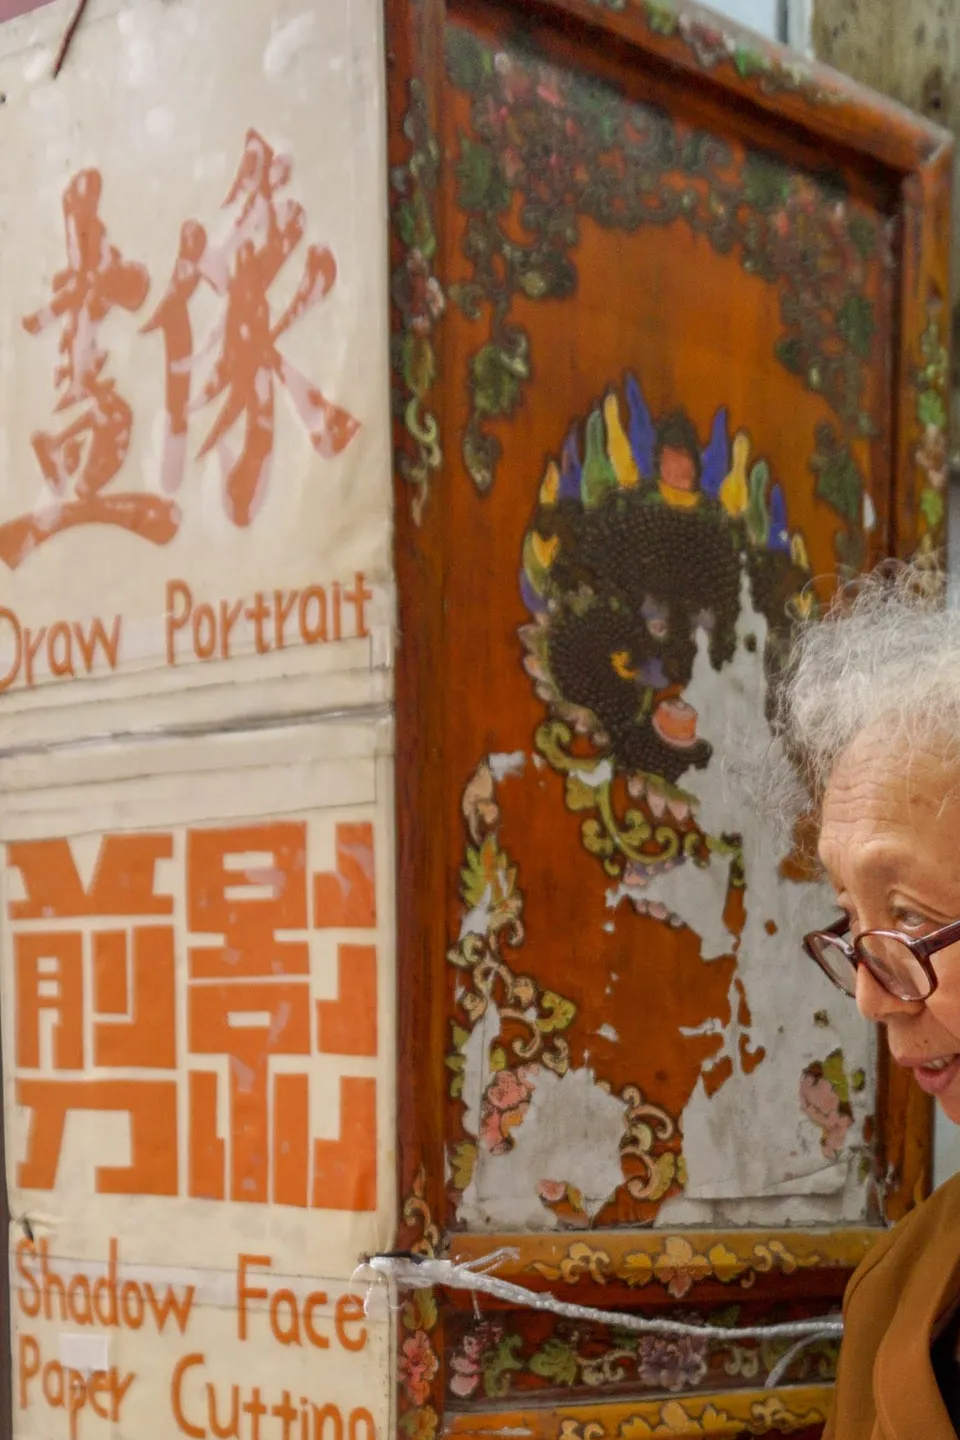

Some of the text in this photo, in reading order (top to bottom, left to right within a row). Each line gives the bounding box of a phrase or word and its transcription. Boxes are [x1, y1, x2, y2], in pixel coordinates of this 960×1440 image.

[165, 571, 373, 666] Portrait
[15, 1236, 368, 1352] Shadow Face
